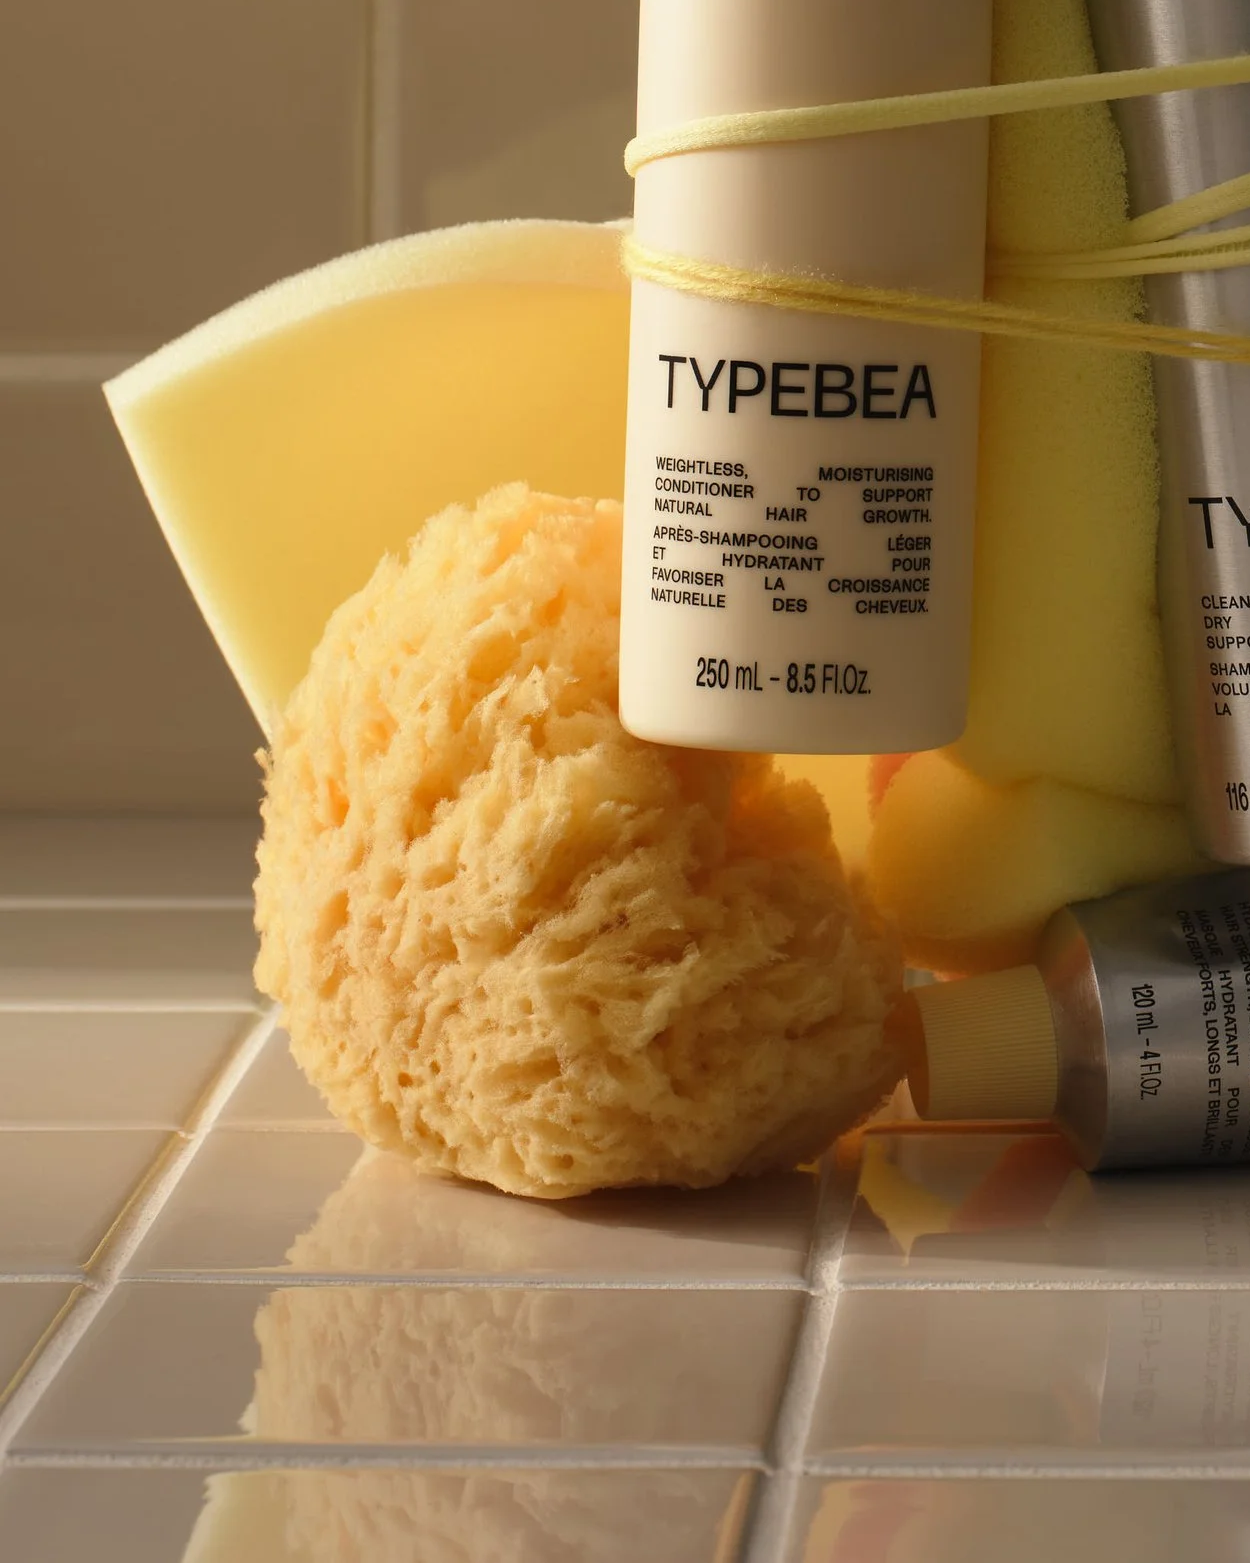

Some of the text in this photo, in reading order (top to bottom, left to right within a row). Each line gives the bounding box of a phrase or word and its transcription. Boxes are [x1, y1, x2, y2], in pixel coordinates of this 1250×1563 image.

[658, 354, 937, 419] TYPEBEA
[655, 455, 934, 482] WEIGHTLESS, MOISTURISING
[655, 477, 933, 503] CONDITIONER TO SUPPORT
[654, 498, 932, 524] NATURAL HAIR GROWTH.
[653, 524, 932, 552] APRÈS-SHAMPOOING LÉGER
[652, 546, 931, 572] ET HYDRATANT POUR
[651, 567, 930, 593] FAVORISER LA CROISSANCE
[651, 588, 929, 614] NATURELLE DES CHEVEUX.
[1204, 616, 1232, 629] DRY
[695, 657, 729, 689] 250
[735, 661, 763, 691] mL
[786, 663, 816, 694] 8.5
[1215, 703, 1232, 716] LA
[1225, 781, 1249, 811] 116
[1220, 905, 1237, 928] HAIR
[1176, 910, 1221, 1096] CHEVEUX FORTS, LONGS ET
[1131, 984, 1161, 1061] 120 mL 4
[1193, 909, 1240, 1127] MASQUE HYDRATANT POUR
